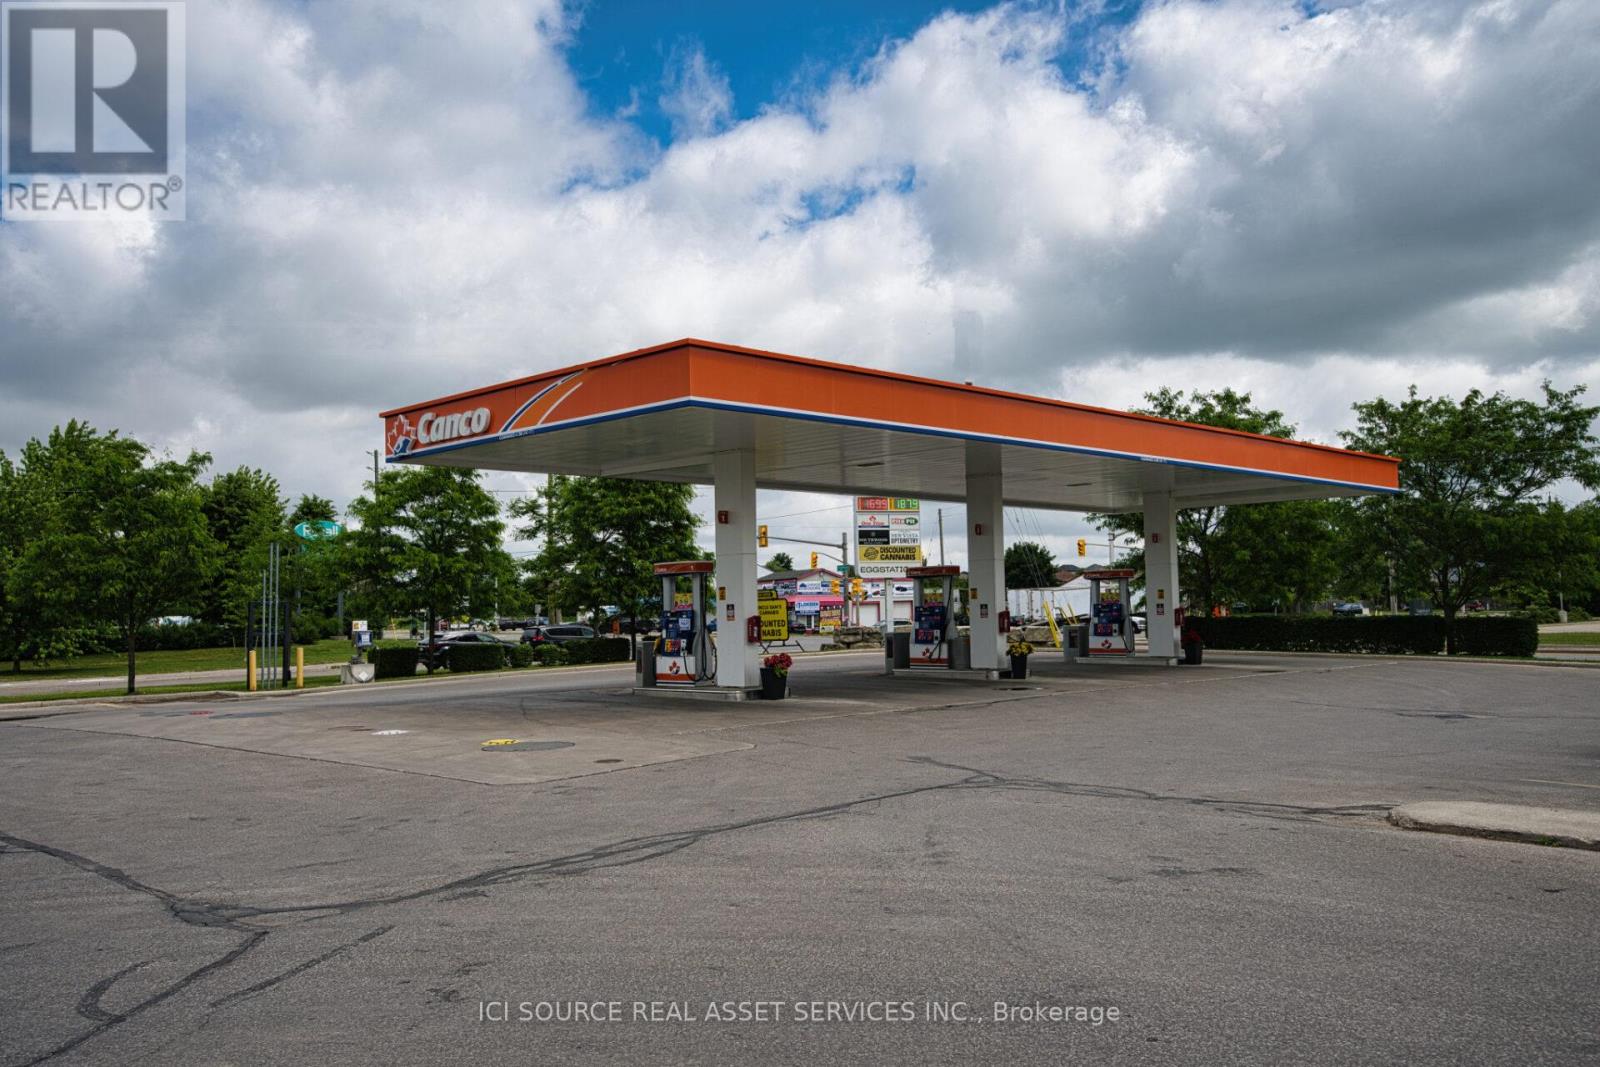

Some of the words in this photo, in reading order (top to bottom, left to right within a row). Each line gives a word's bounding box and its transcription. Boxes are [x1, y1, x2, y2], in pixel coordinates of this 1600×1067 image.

[417, 407, 491, 444] Canco
[302, 525, 338, 537] Rall
[760, 620, 786, 628] OUNTED
[762, 629, 782, 637] NABIS
